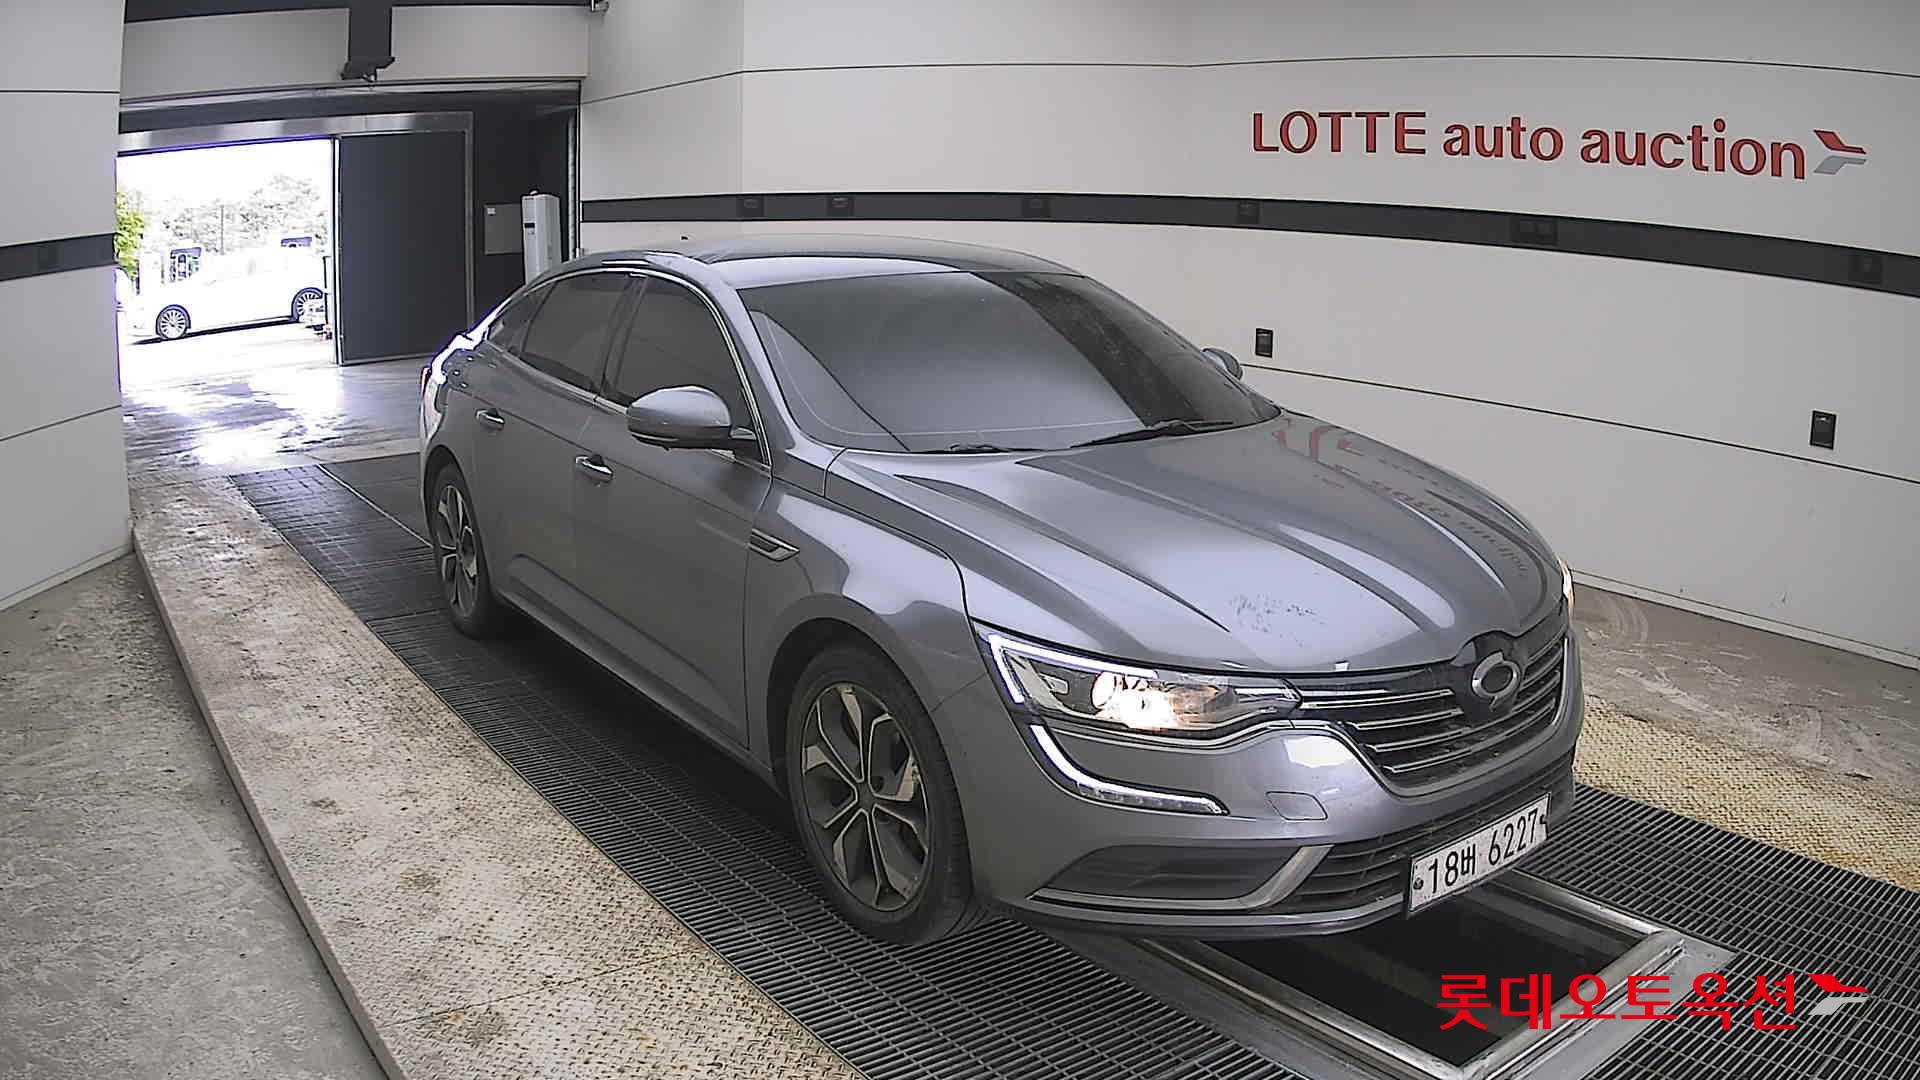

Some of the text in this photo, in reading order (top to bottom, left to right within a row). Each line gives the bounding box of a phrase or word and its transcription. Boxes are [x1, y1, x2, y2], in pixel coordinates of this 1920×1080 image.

[1253, 111, 1806, 180] LOTTE auto auction
[1428, 808, 1538, 893] 18버 6227
